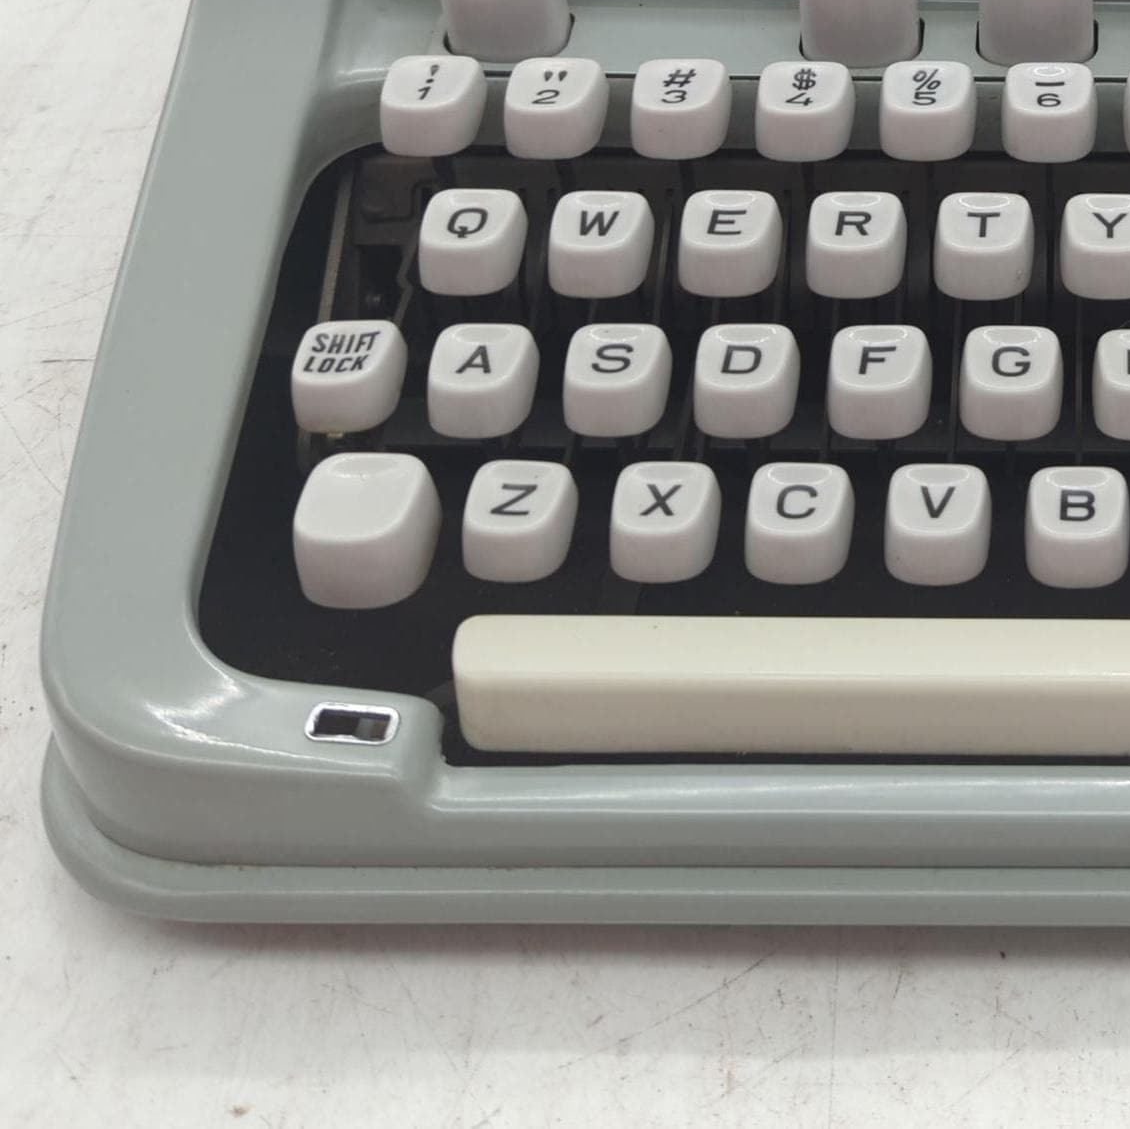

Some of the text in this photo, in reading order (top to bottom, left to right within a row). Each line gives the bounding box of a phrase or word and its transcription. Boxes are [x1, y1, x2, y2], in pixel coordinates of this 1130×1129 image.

[425, 64, 439, 84] !
[663, 69, 697, 88] #
[791, 68, 817, 91] $
[912, 69, 942, 92] %
[418, 85, 432, 101] 1
[531, 89, 561, 105] 2
[661, 89, 688, 104] 3
[785, 92, 814, 107] 4
[912, 91, 937, 106] 5
[1036, 92, 1062, 108] 6
[446, 207, 489, 239] Q
[579, 210, 620, 237] W
[706, 209, 747, 236] E
[834, 211, 872, 236] R
[967, 212, 1001, 238] T
[1092, 212, 1127, 239] Y
[312, 330, 381, 355] SHIFT
[303, 354, 369, 374] LOCK
[455, 345, 492, 375] A
[591, 343, 634, 374] S
[720, 345, 762, 375] D
[858, 346, 897, 375] F
[991, 346, 1031, 378] G
[490, 483, 538, 517] Z
[640, 484, 682, 517] X
[776, 484, 818, 520] C
[921, 486, 956, 519] V
[1059, 489, 1096, 522] B
